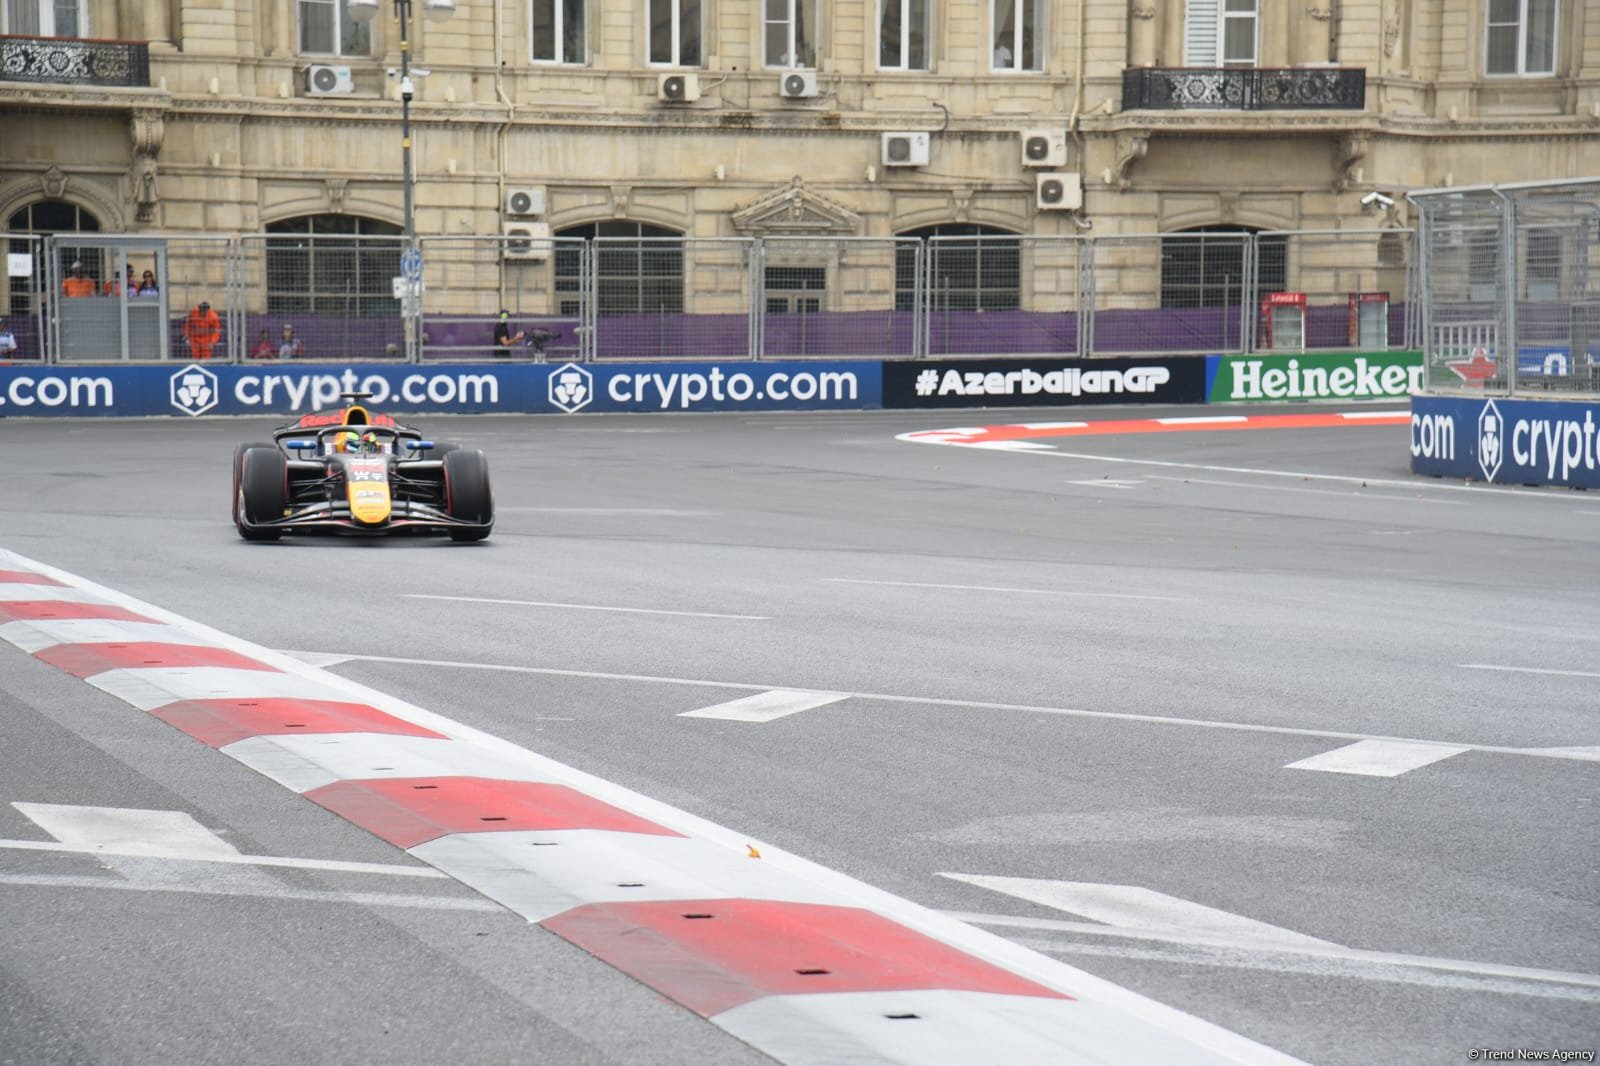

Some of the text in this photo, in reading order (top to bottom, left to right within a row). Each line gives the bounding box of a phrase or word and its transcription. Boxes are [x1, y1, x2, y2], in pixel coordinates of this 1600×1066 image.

[234, 368, 499, 411] crypto.com
[608, 367, 858, 408] crypto.com
[915, 366, 1170, 396] #AzerbaijanGP
[1512, 410, 1600, 481] crypt
